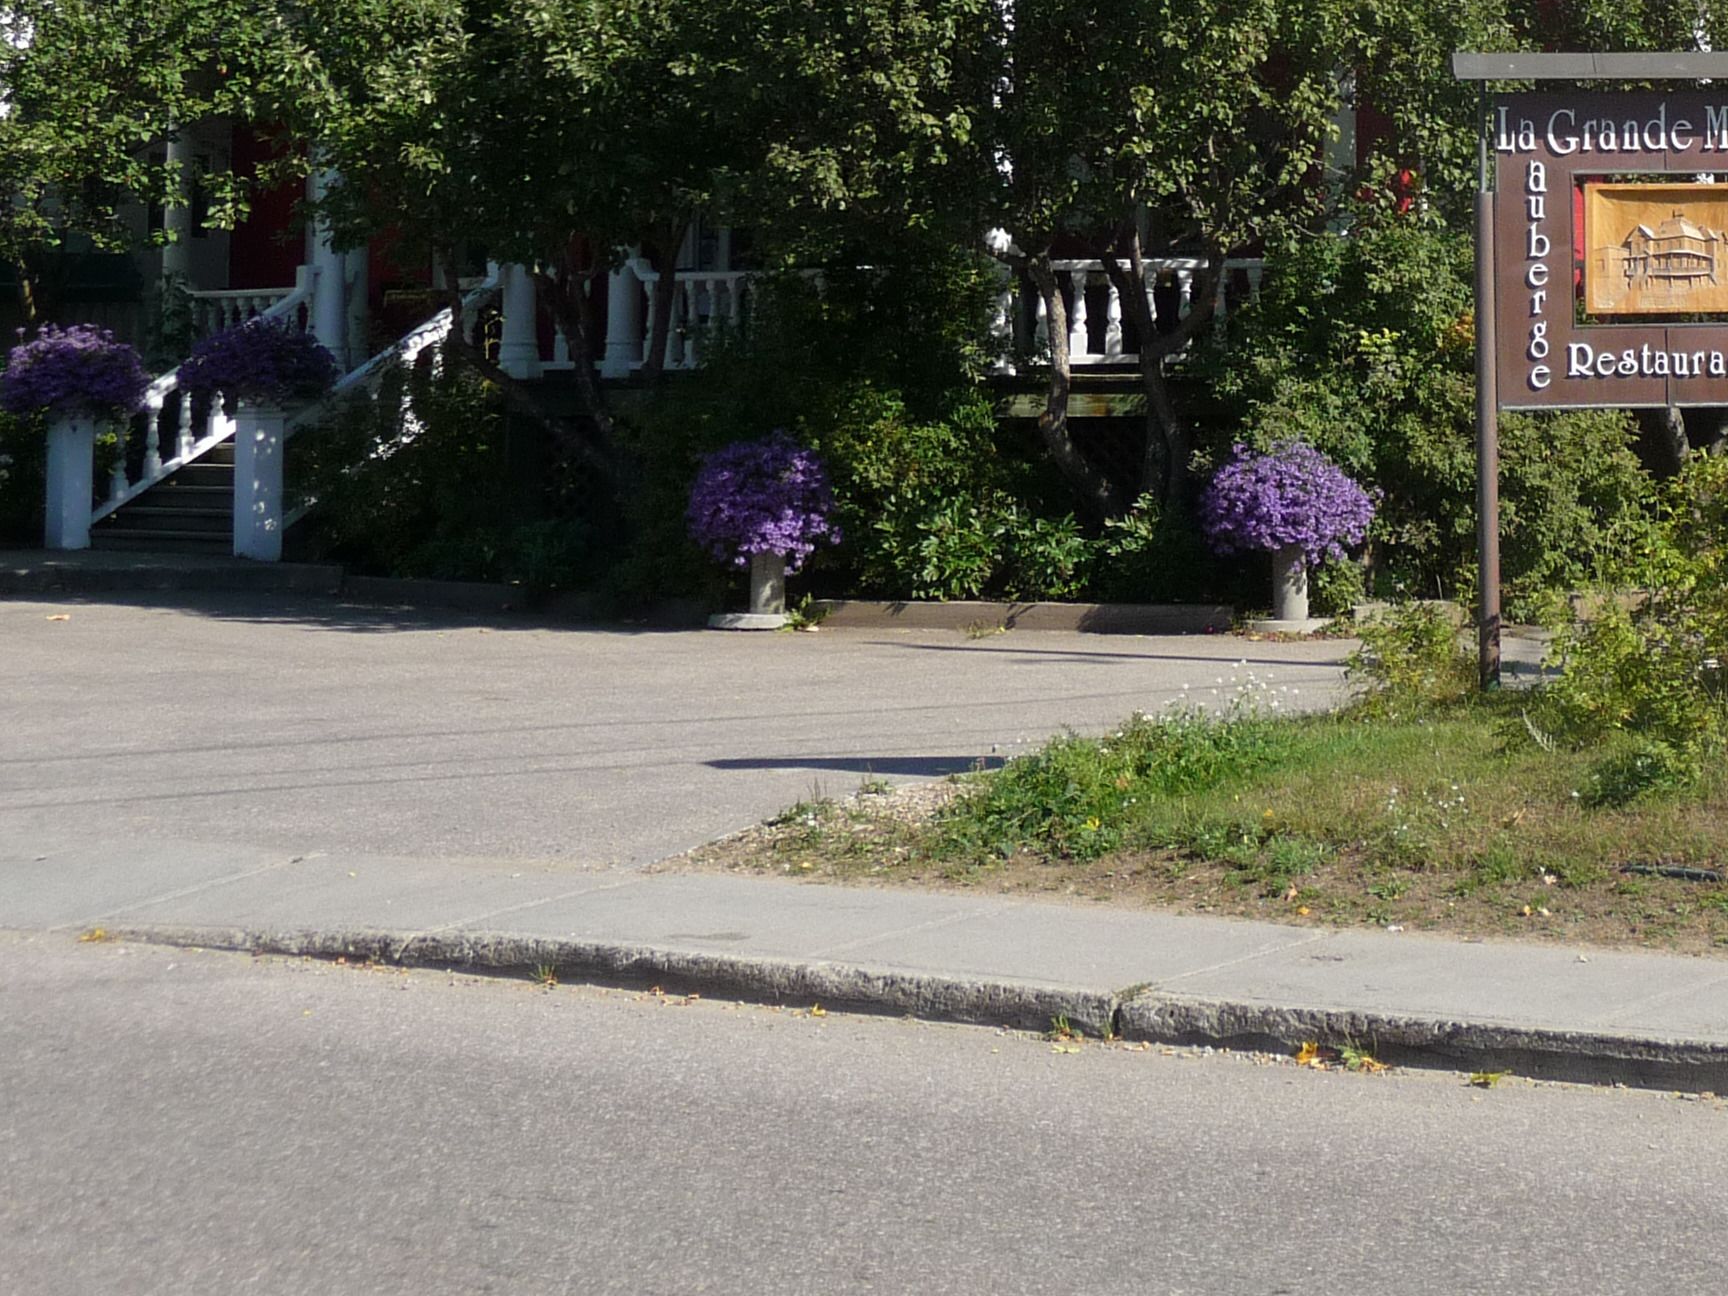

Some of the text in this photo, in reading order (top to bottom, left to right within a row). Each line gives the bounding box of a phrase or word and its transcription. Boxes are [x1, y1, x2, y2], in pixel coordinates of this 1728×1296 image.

[1497, 106, 1536, 152] La
[1547, 102, 1693, 153] Grande
[1528, 160, 1551, 388] auberge
